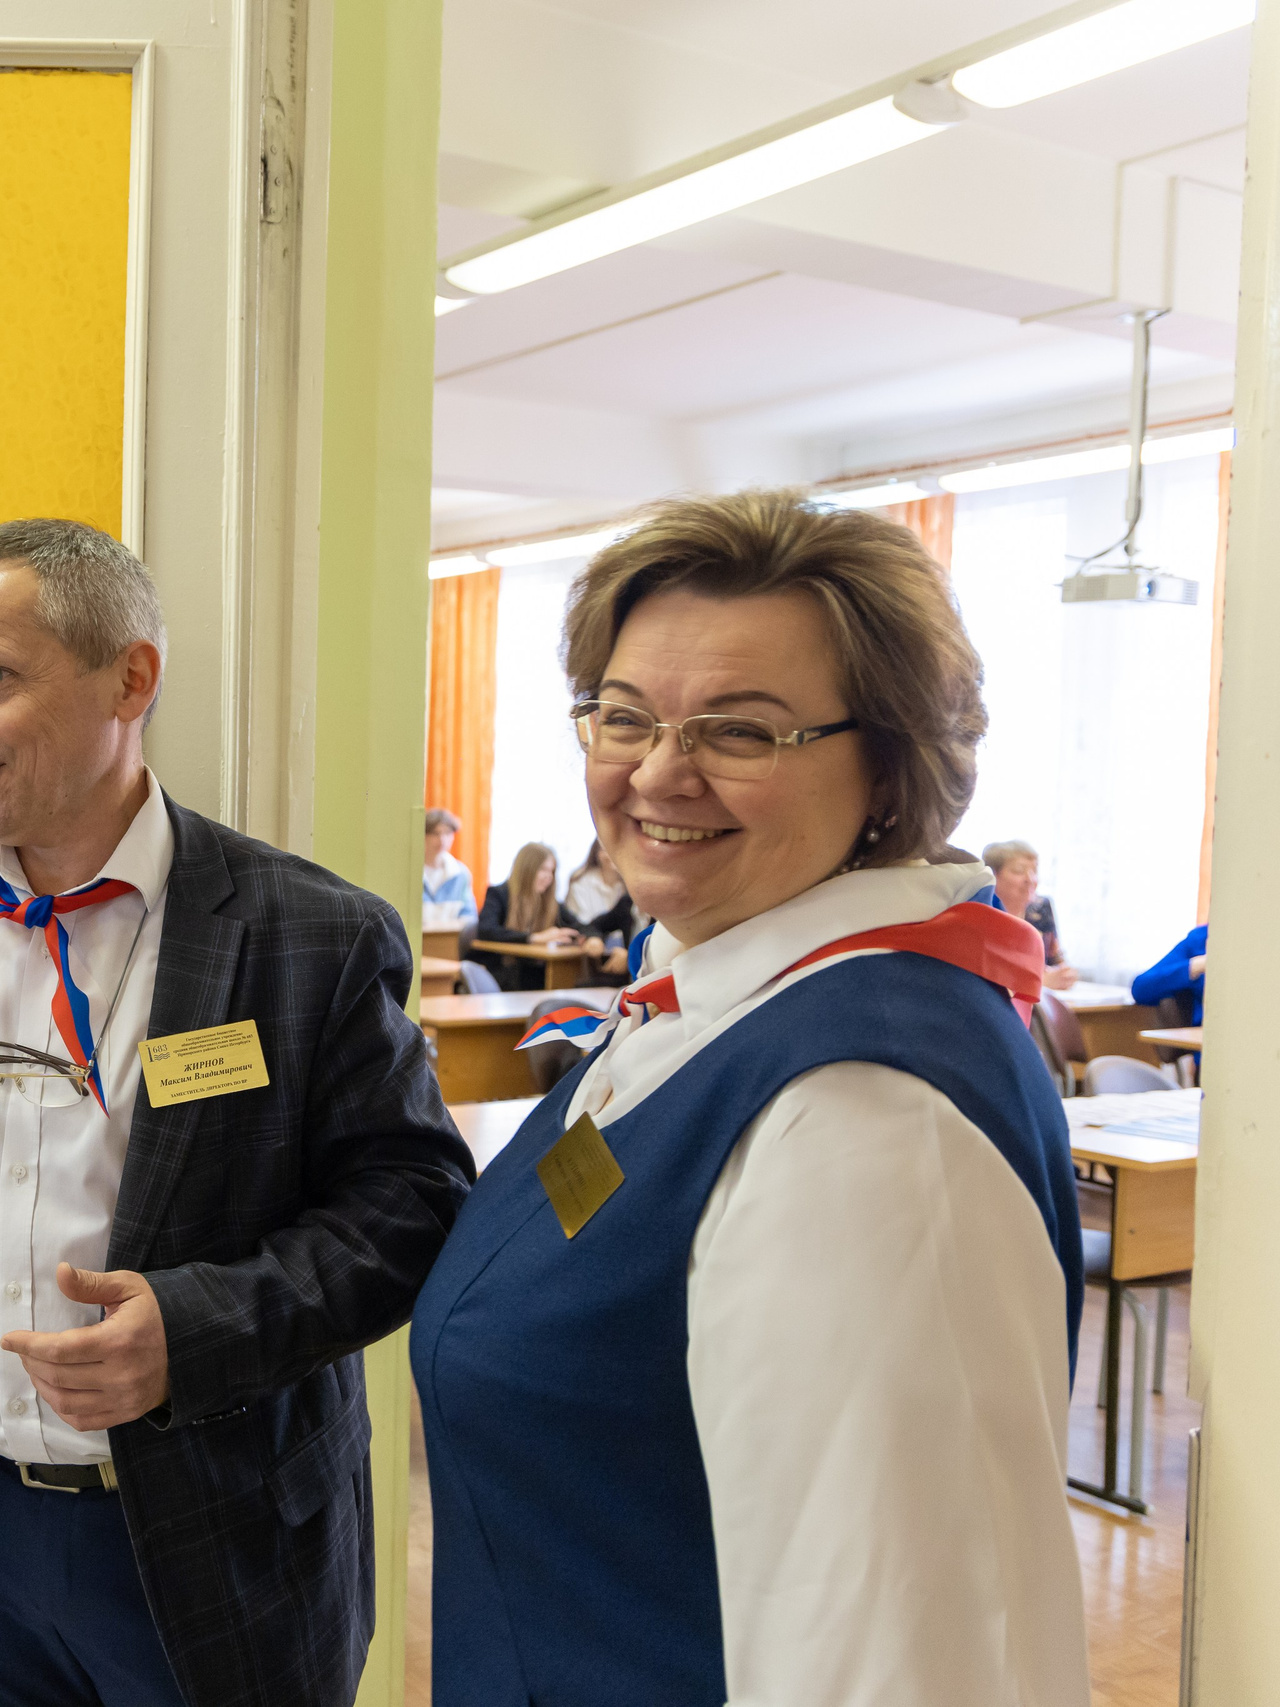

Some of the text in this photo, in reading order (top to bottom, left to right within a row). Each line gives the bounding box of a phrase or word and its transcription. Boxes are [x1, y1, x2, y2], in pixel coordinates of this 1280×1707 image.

[153, 1044, 167, 1053] 683
[184, 1057, 224, 1072] ЖИРНОВ
[160, 1064, 252, 1087] Максим Владимирович
[171, 1088, 205, 1098] ЗАМЕСТИТЕЛЬ
[206, 1082, 233, 1091] ДИРЕКТОРА
